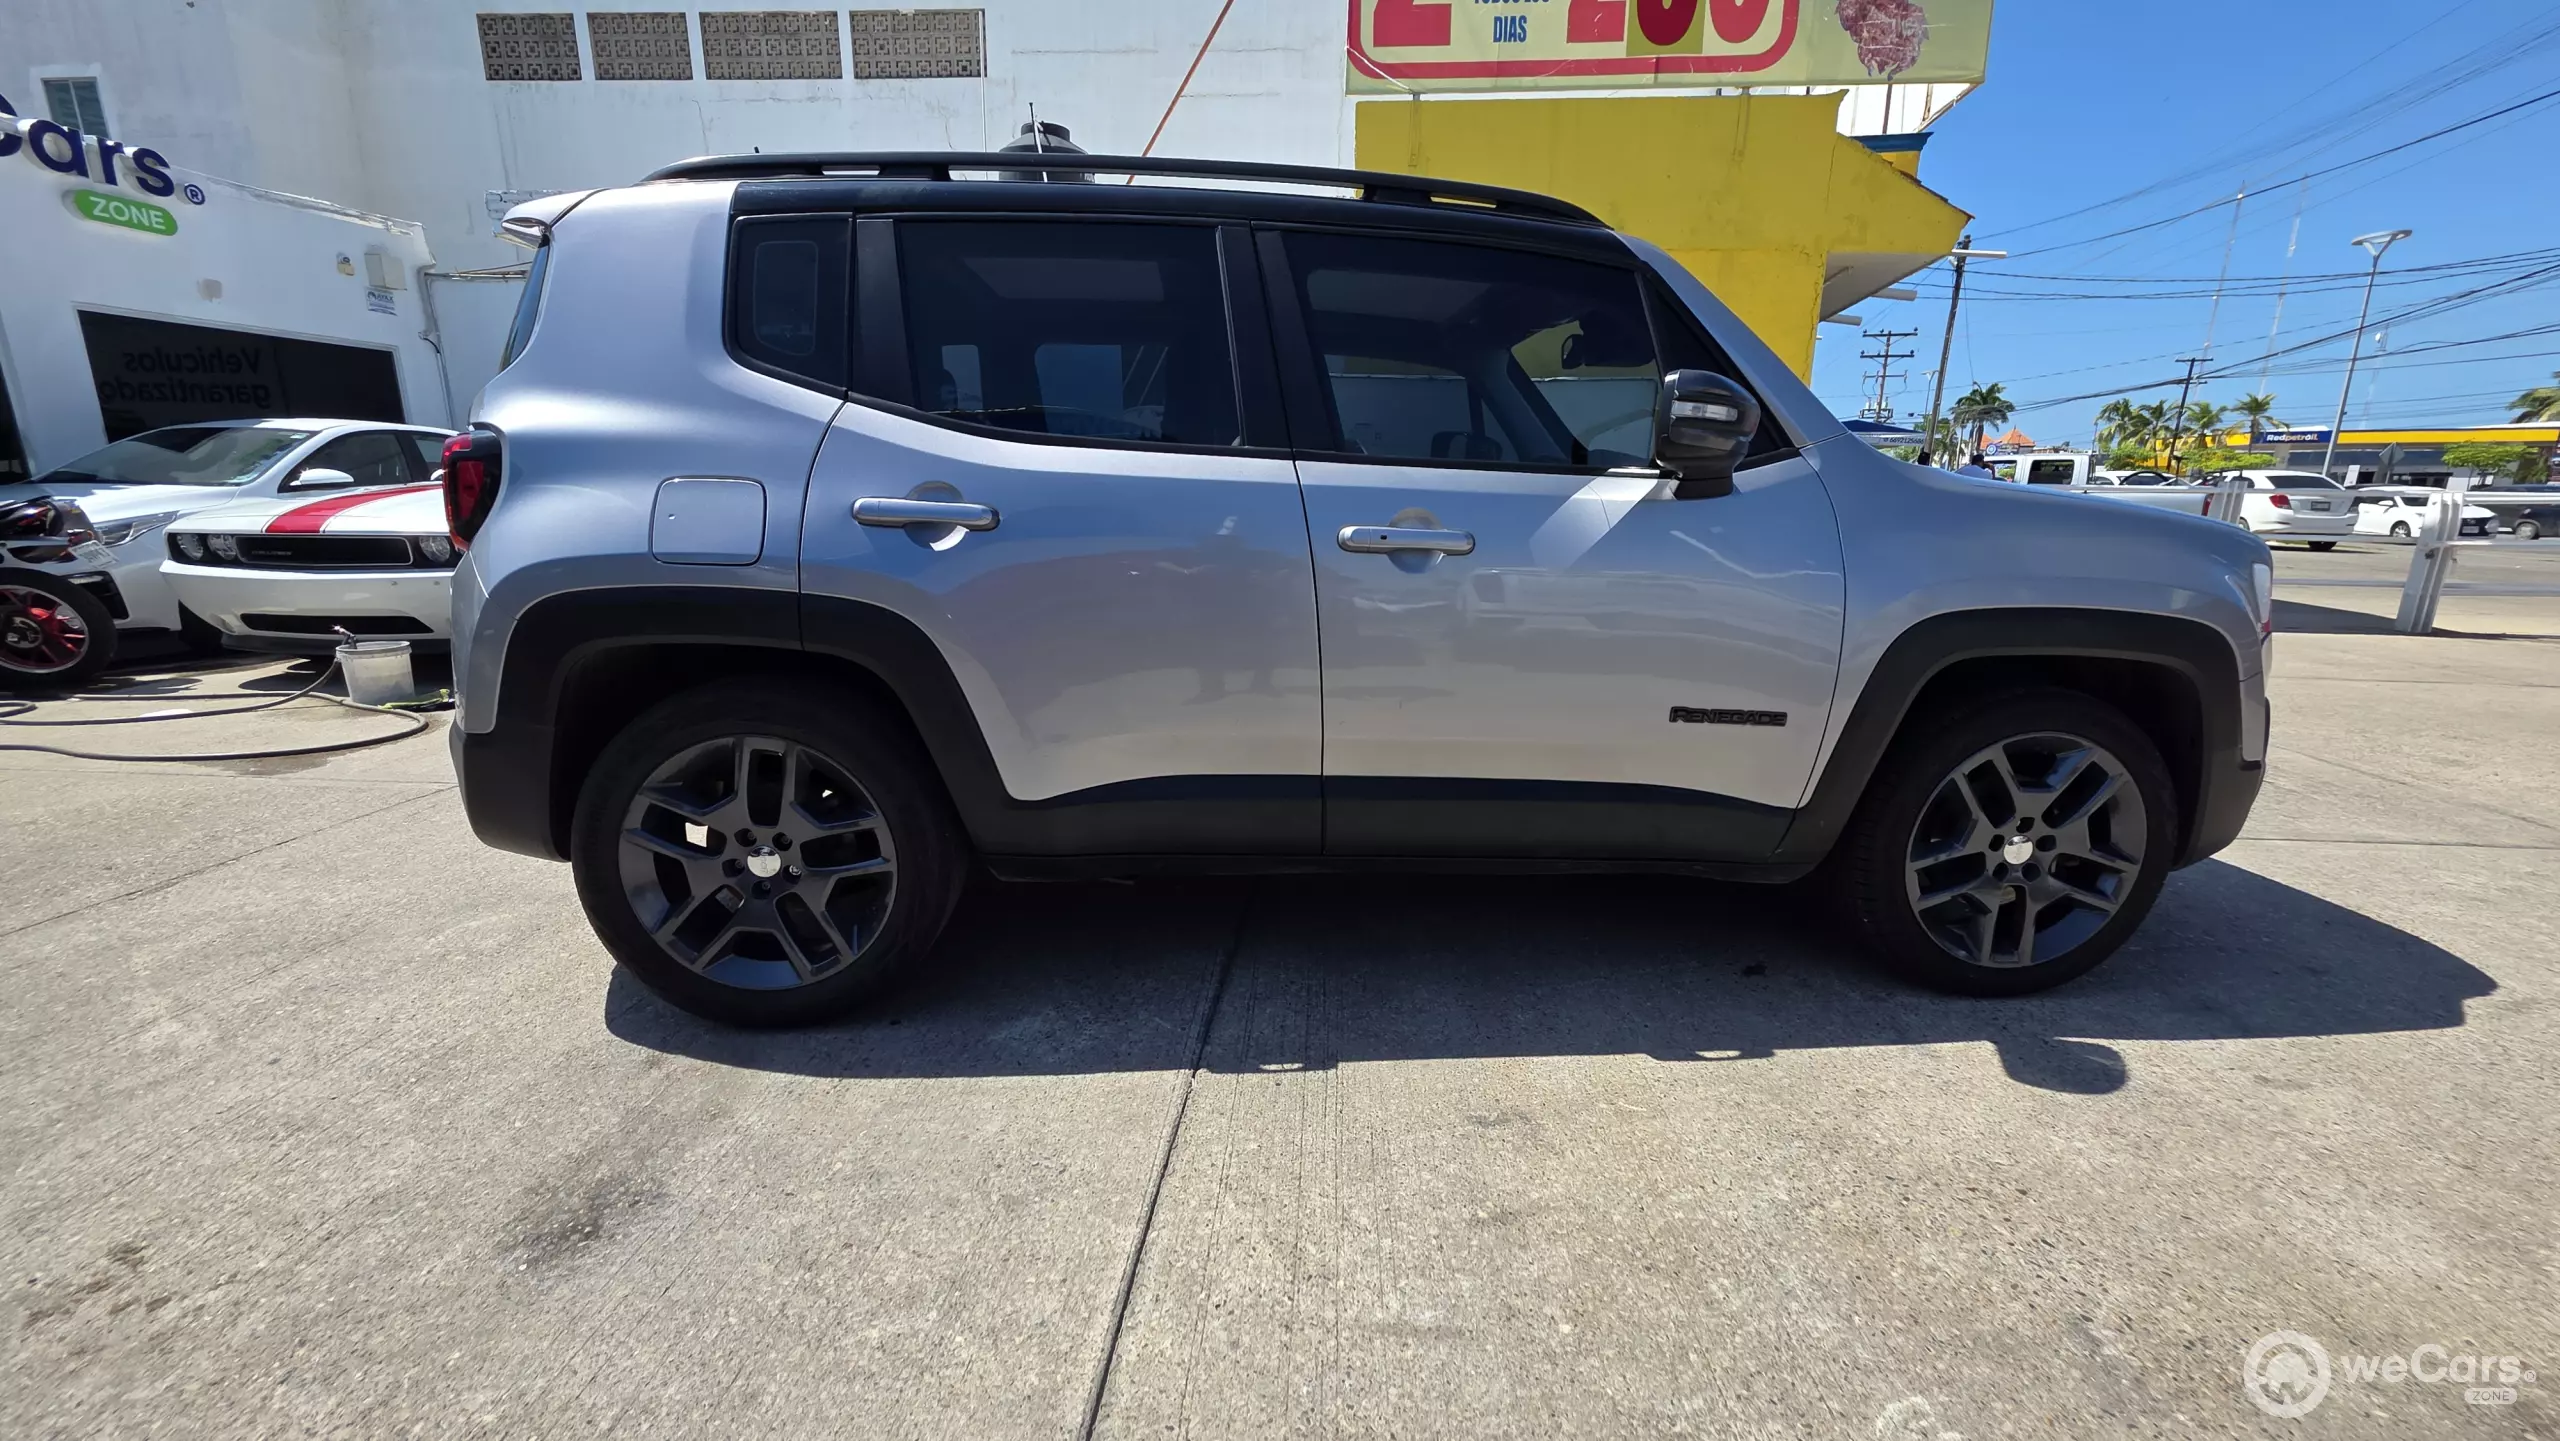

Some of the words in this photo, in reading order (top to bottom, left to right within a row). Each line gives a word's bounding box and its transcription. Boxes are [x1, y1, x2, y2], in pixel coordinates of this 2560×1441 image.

[1493, 15, 1527, 43] DIAS
[89, 196, 166, 229] ZONE
[1669, 706, 1787, 726] RENEGADE
